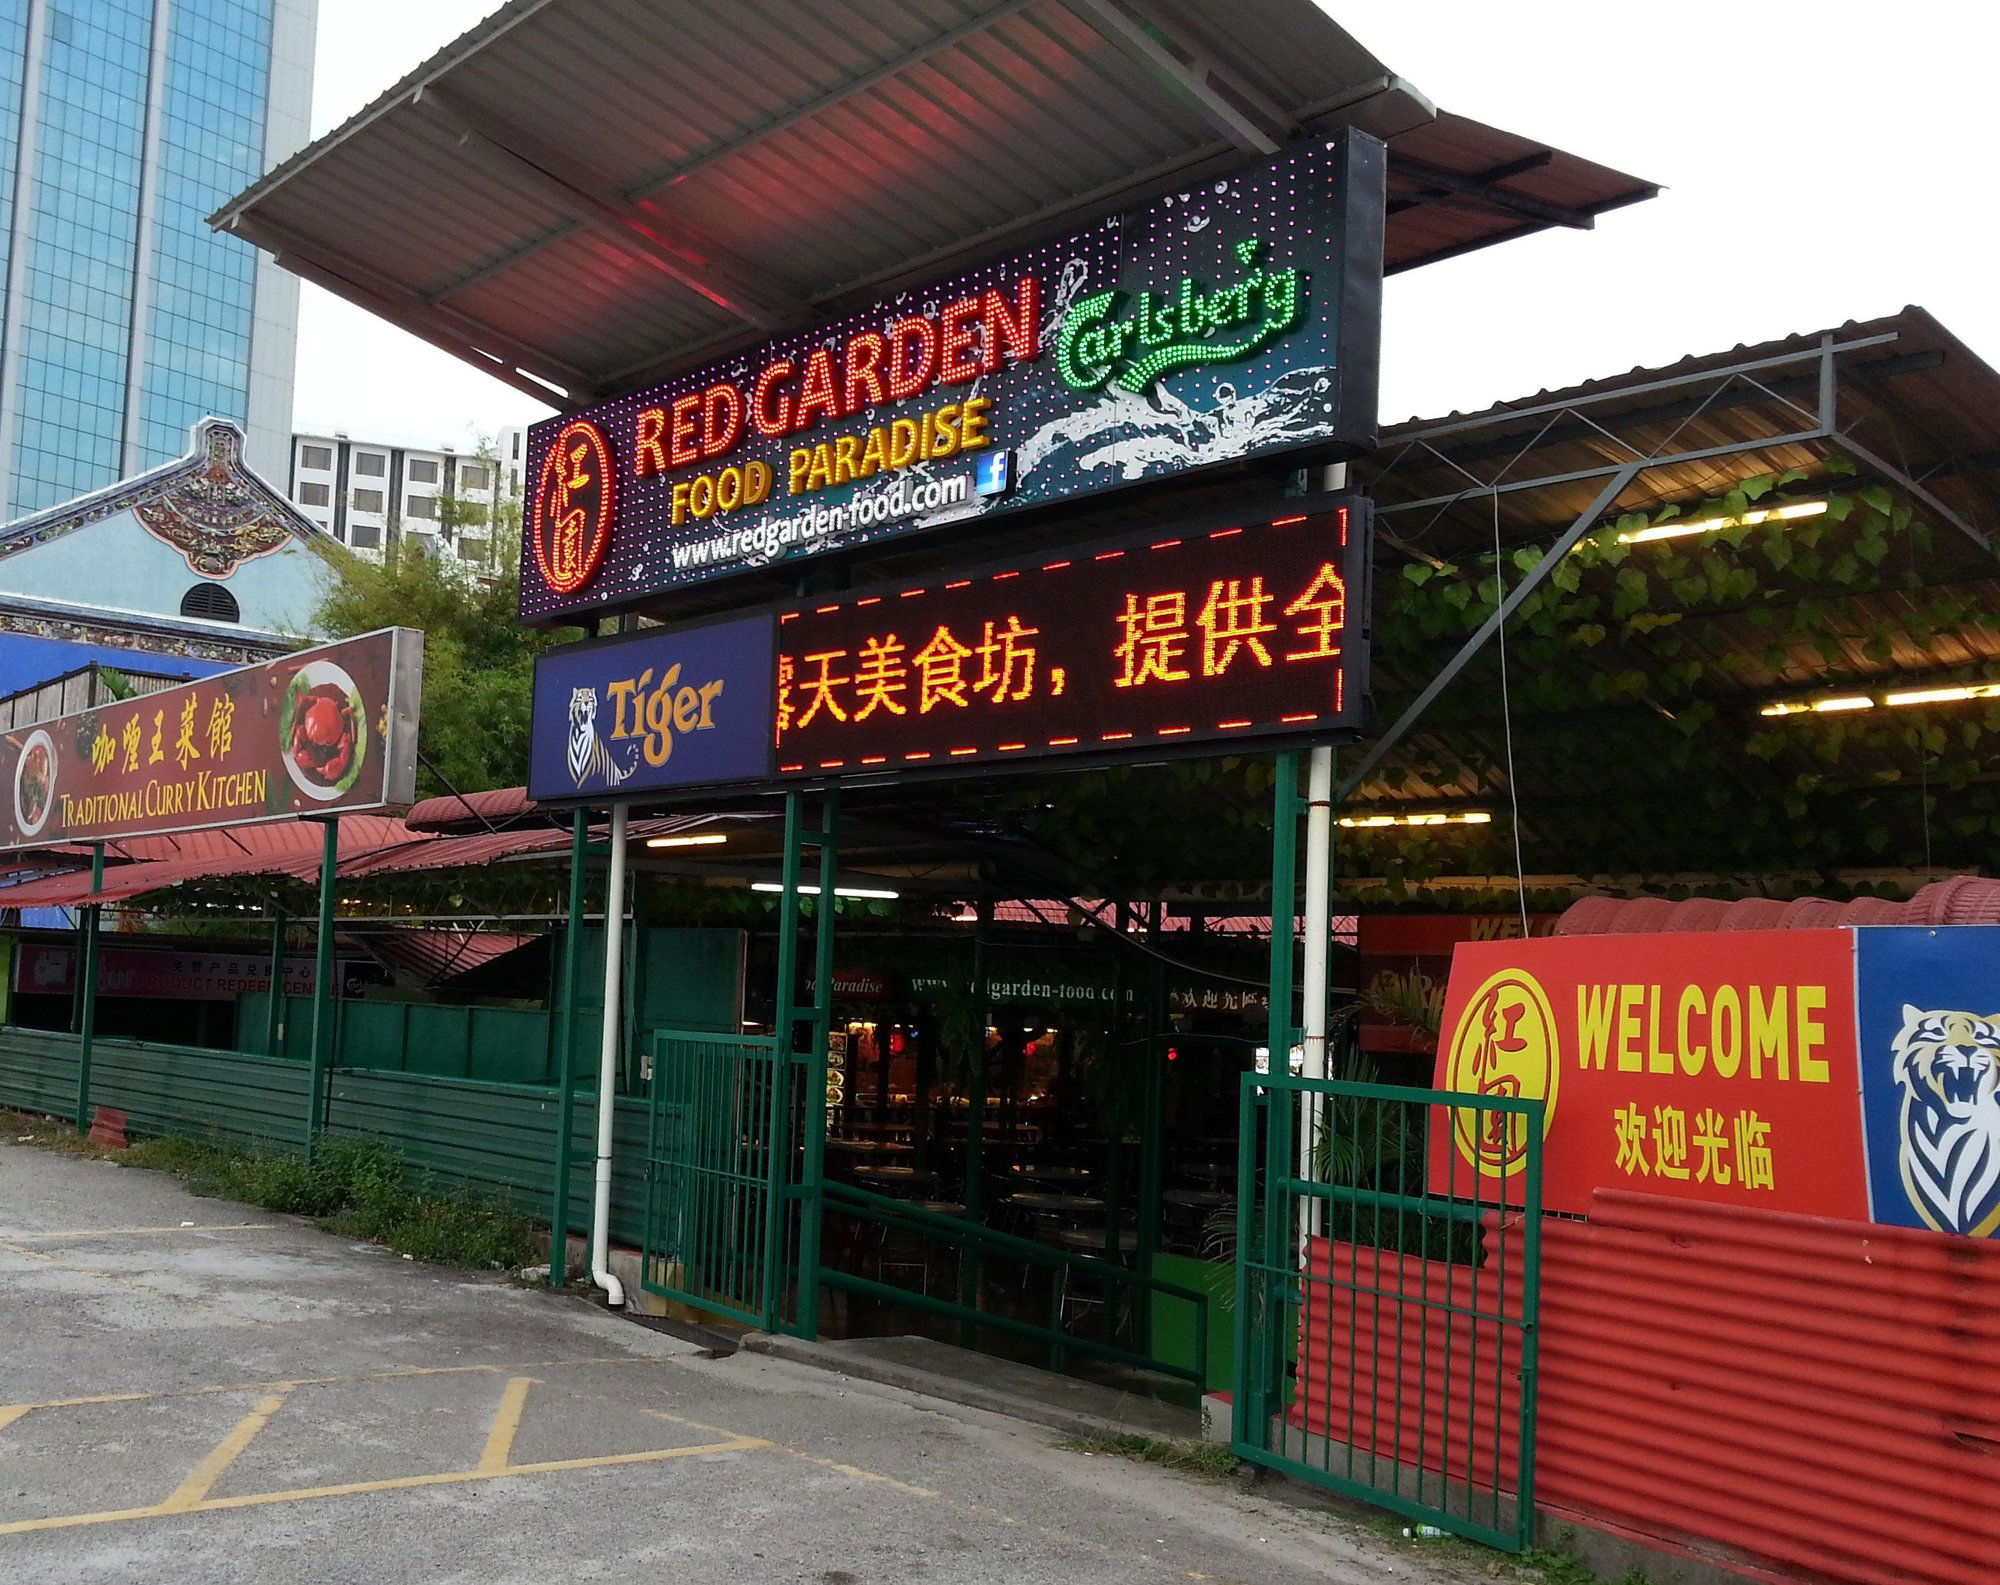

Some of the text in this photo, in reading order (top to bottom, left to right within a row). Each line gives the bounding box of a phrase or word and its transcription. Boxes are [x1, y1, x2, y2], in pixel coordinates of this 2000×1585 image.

[635, 277, 1040, 478] RED GARDEN
[1056, 262, 1299, 391] Carlsberg
[671, 397, 991, 526] FOOD PARADISE
[671, 474, 968, 569] www.redgarden-food.com
[606, 662, 725, 768] Tiger
[60, 769, 268, 828] TRADITIONAL CURRY KITCHEN
[1577, 984, 1830, 1083] WELCOME
[1614, 1101, 1775, 1190] 欢迎光临
